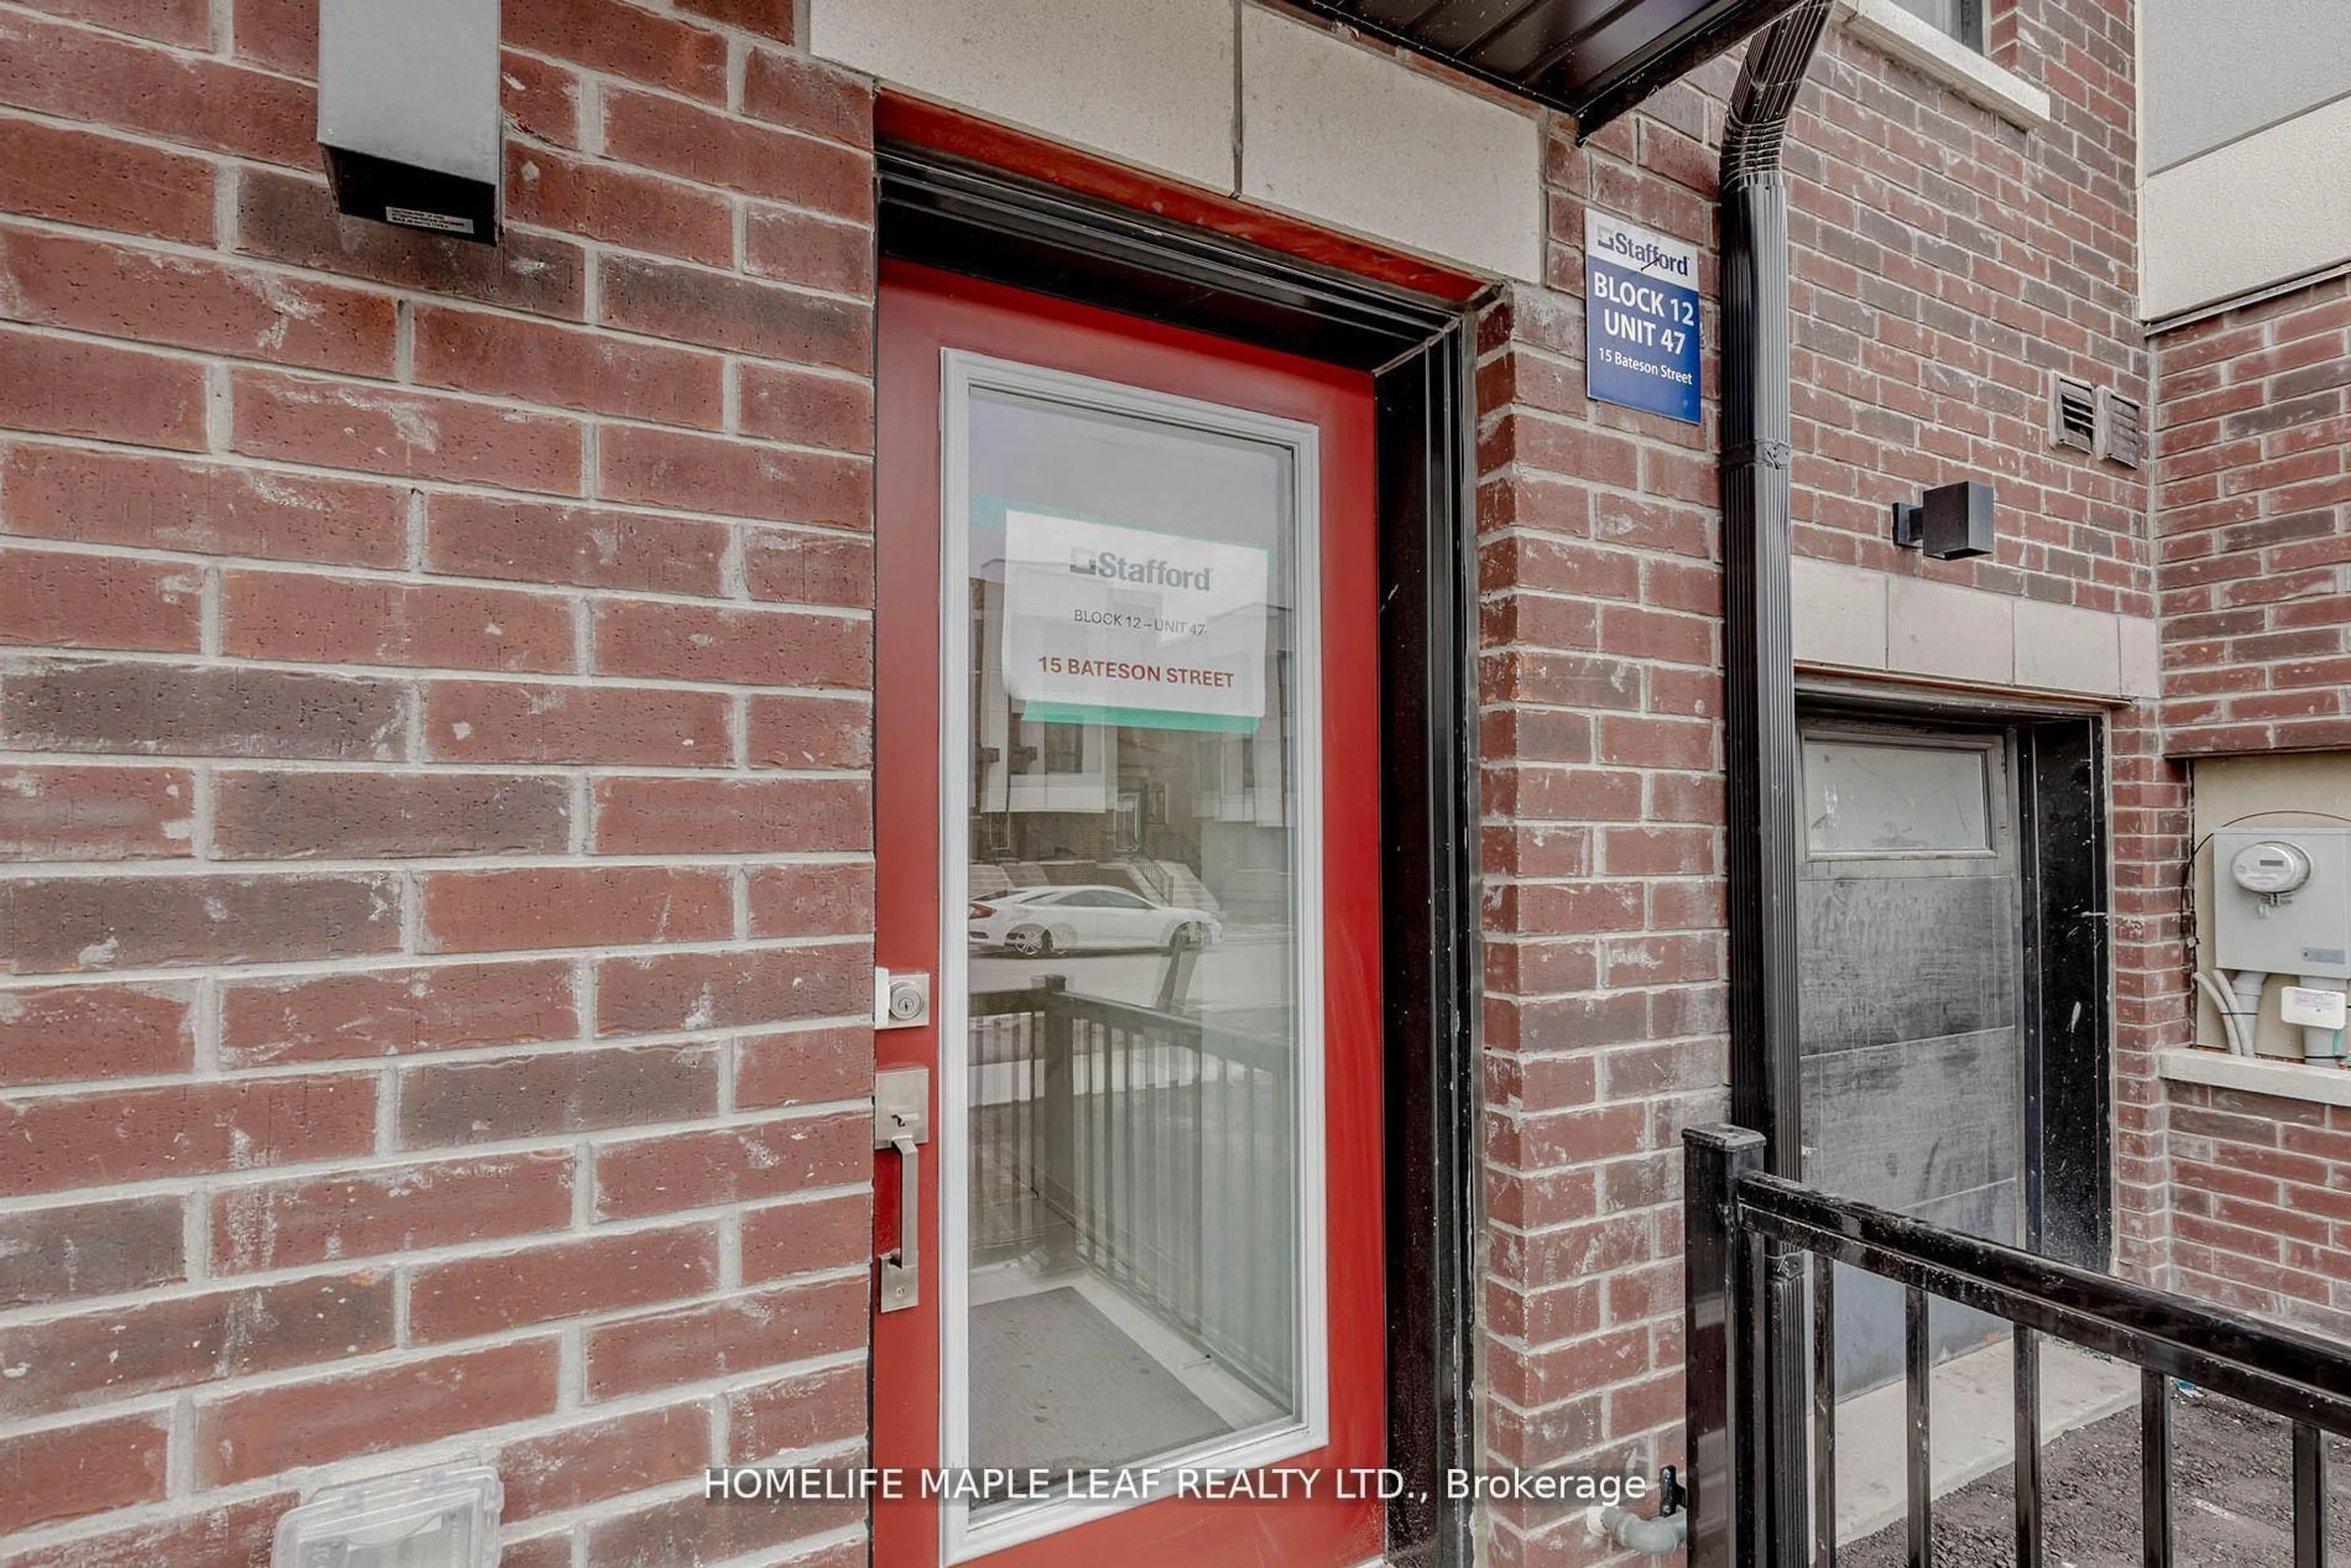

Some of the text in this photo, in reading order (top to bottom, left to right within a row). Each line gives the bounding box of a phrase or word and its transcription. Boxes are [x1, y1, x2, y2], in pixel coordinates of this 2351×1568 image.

[1594, 271, 1694, 326] BLOCK 12
[1604, 308, 1686, 355] UNIT 47
[1599, 347, 1692, 384] 15 Bateson Street
[1098, 552, 1210, 591] Stafford
[1074, 609, 1121, 627] BLOCK
[1127, 616, 1141, 629] 12
[1154, 620, 1187, 635] UNIT
[1190, 623, 1205, 636] 47
[1039, 656, 1234, 688] 15 BATESON STREET
